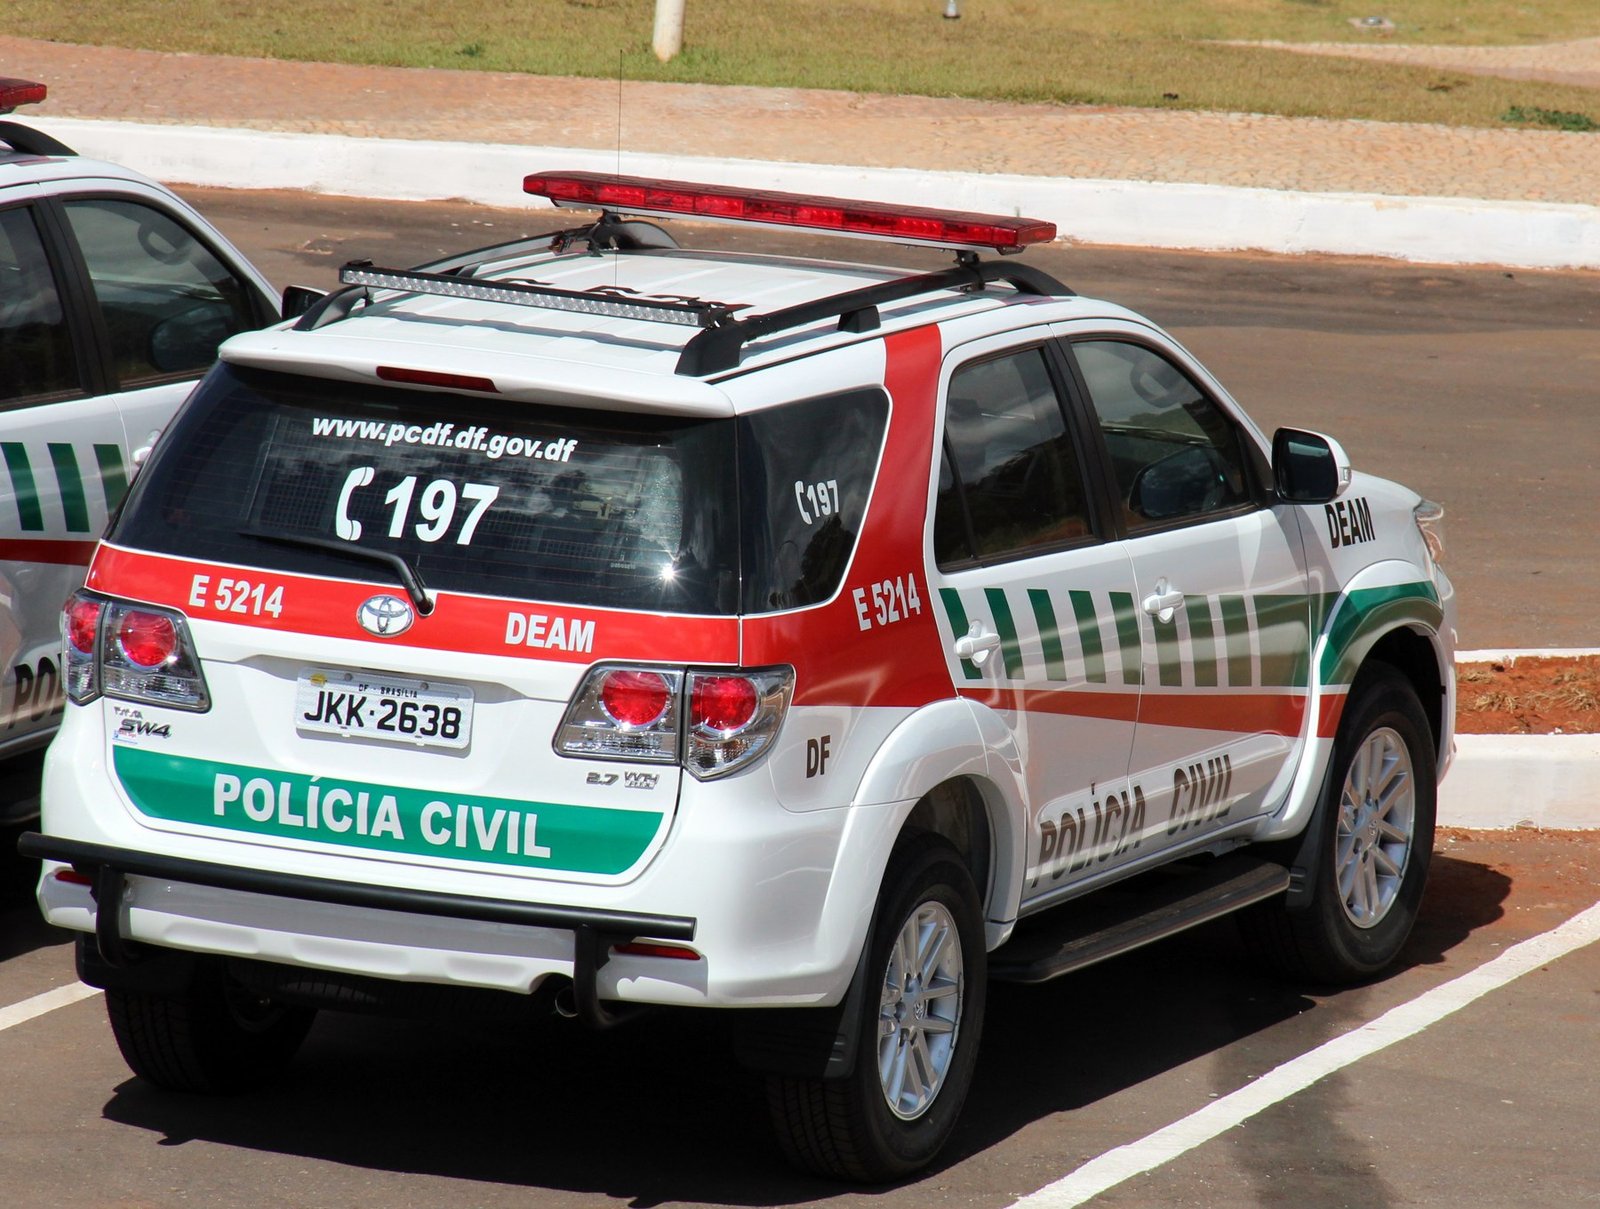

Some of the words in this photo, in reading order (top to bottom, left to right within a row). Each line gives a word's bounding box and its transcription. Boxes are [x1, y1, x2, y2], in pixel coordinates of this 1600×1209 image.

[312, 417, 578, 463] www.pcdf.df.gov.df
[385, 475, 500, 546] 197
[806, 479, 839, 518] 197
[1324, 497, 1376, 549] DEAM
[188, 574, 210, 608] E
[214, 578, 285, 618] 5214
[852, 587, 872, 631] E
[871, 572, 921, 626] 5214
[504, 612, 596, 653] DEAM
[358, 683, 369, 692] DF
[119, 718, 172, 738] SW4
[806, 734, 831, 779] DF
[213, 773, 404, 841] POLÍCIA
[420, 800, 551, 859] CIVIL
[1031, 781, 1146, 888] POLÍCIA
[1168, 754, 1232, 836] CIVIL
